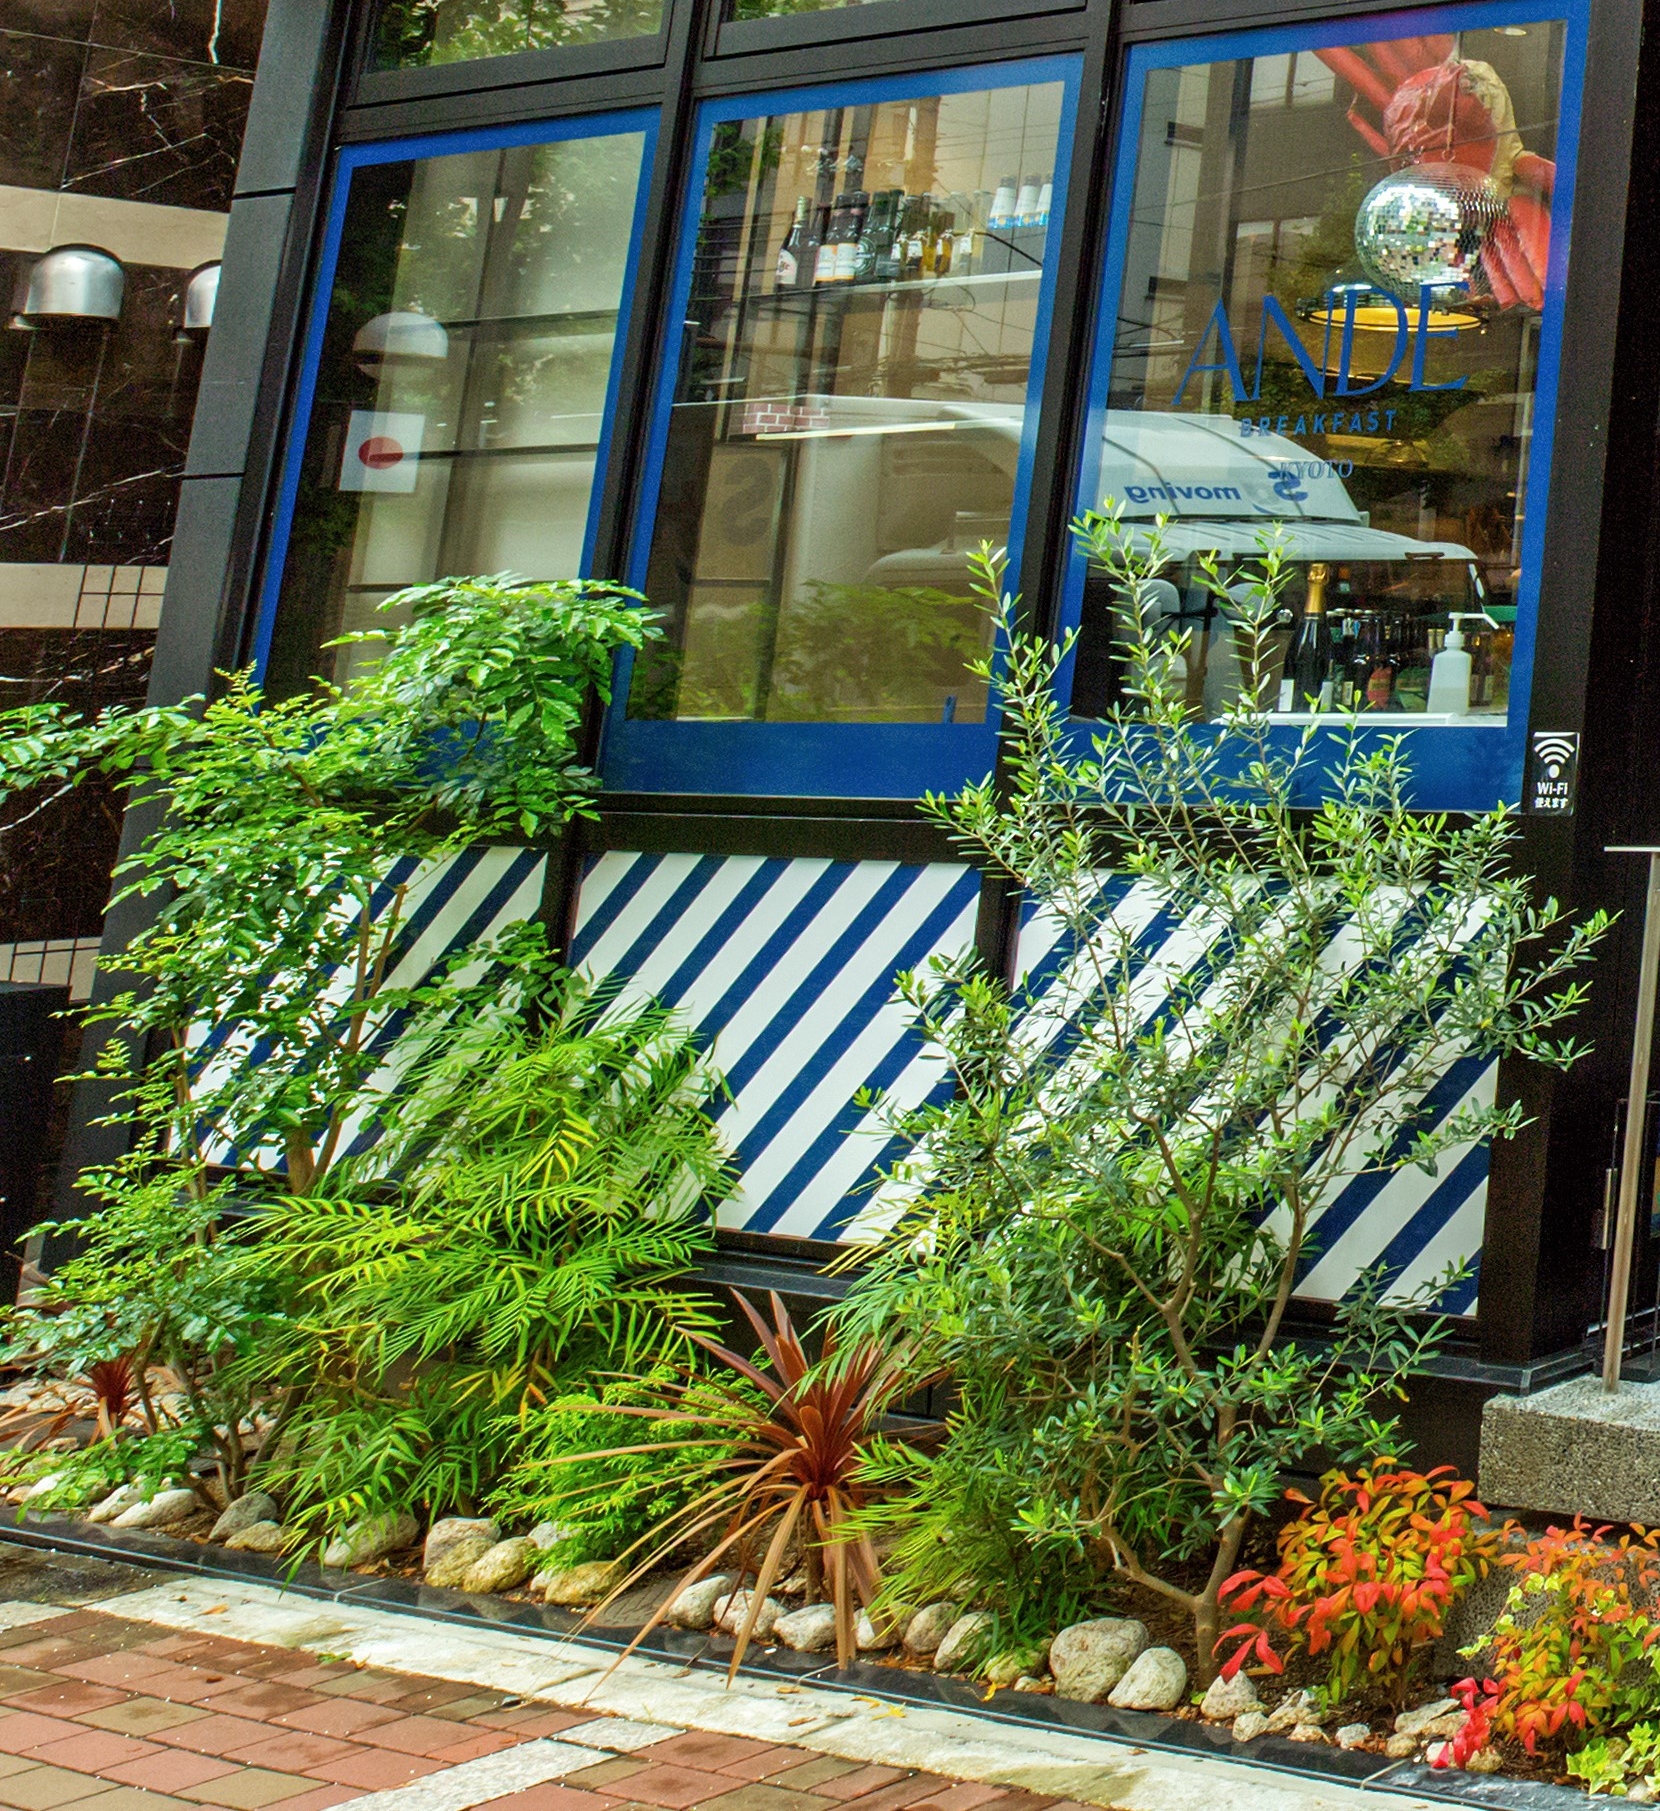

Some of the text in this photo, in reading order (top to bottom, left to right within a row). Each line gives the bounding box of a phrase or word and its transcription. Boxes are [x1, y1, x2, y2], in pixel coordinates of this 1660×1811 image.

[1171, 281, 1470, 406] ANDE
[1239, 409, 1397, 438] BREAKFAST
[1279, 459, 1354, 480] KYOTO
[1537, 781, 1569, 795] Wi-Fi
